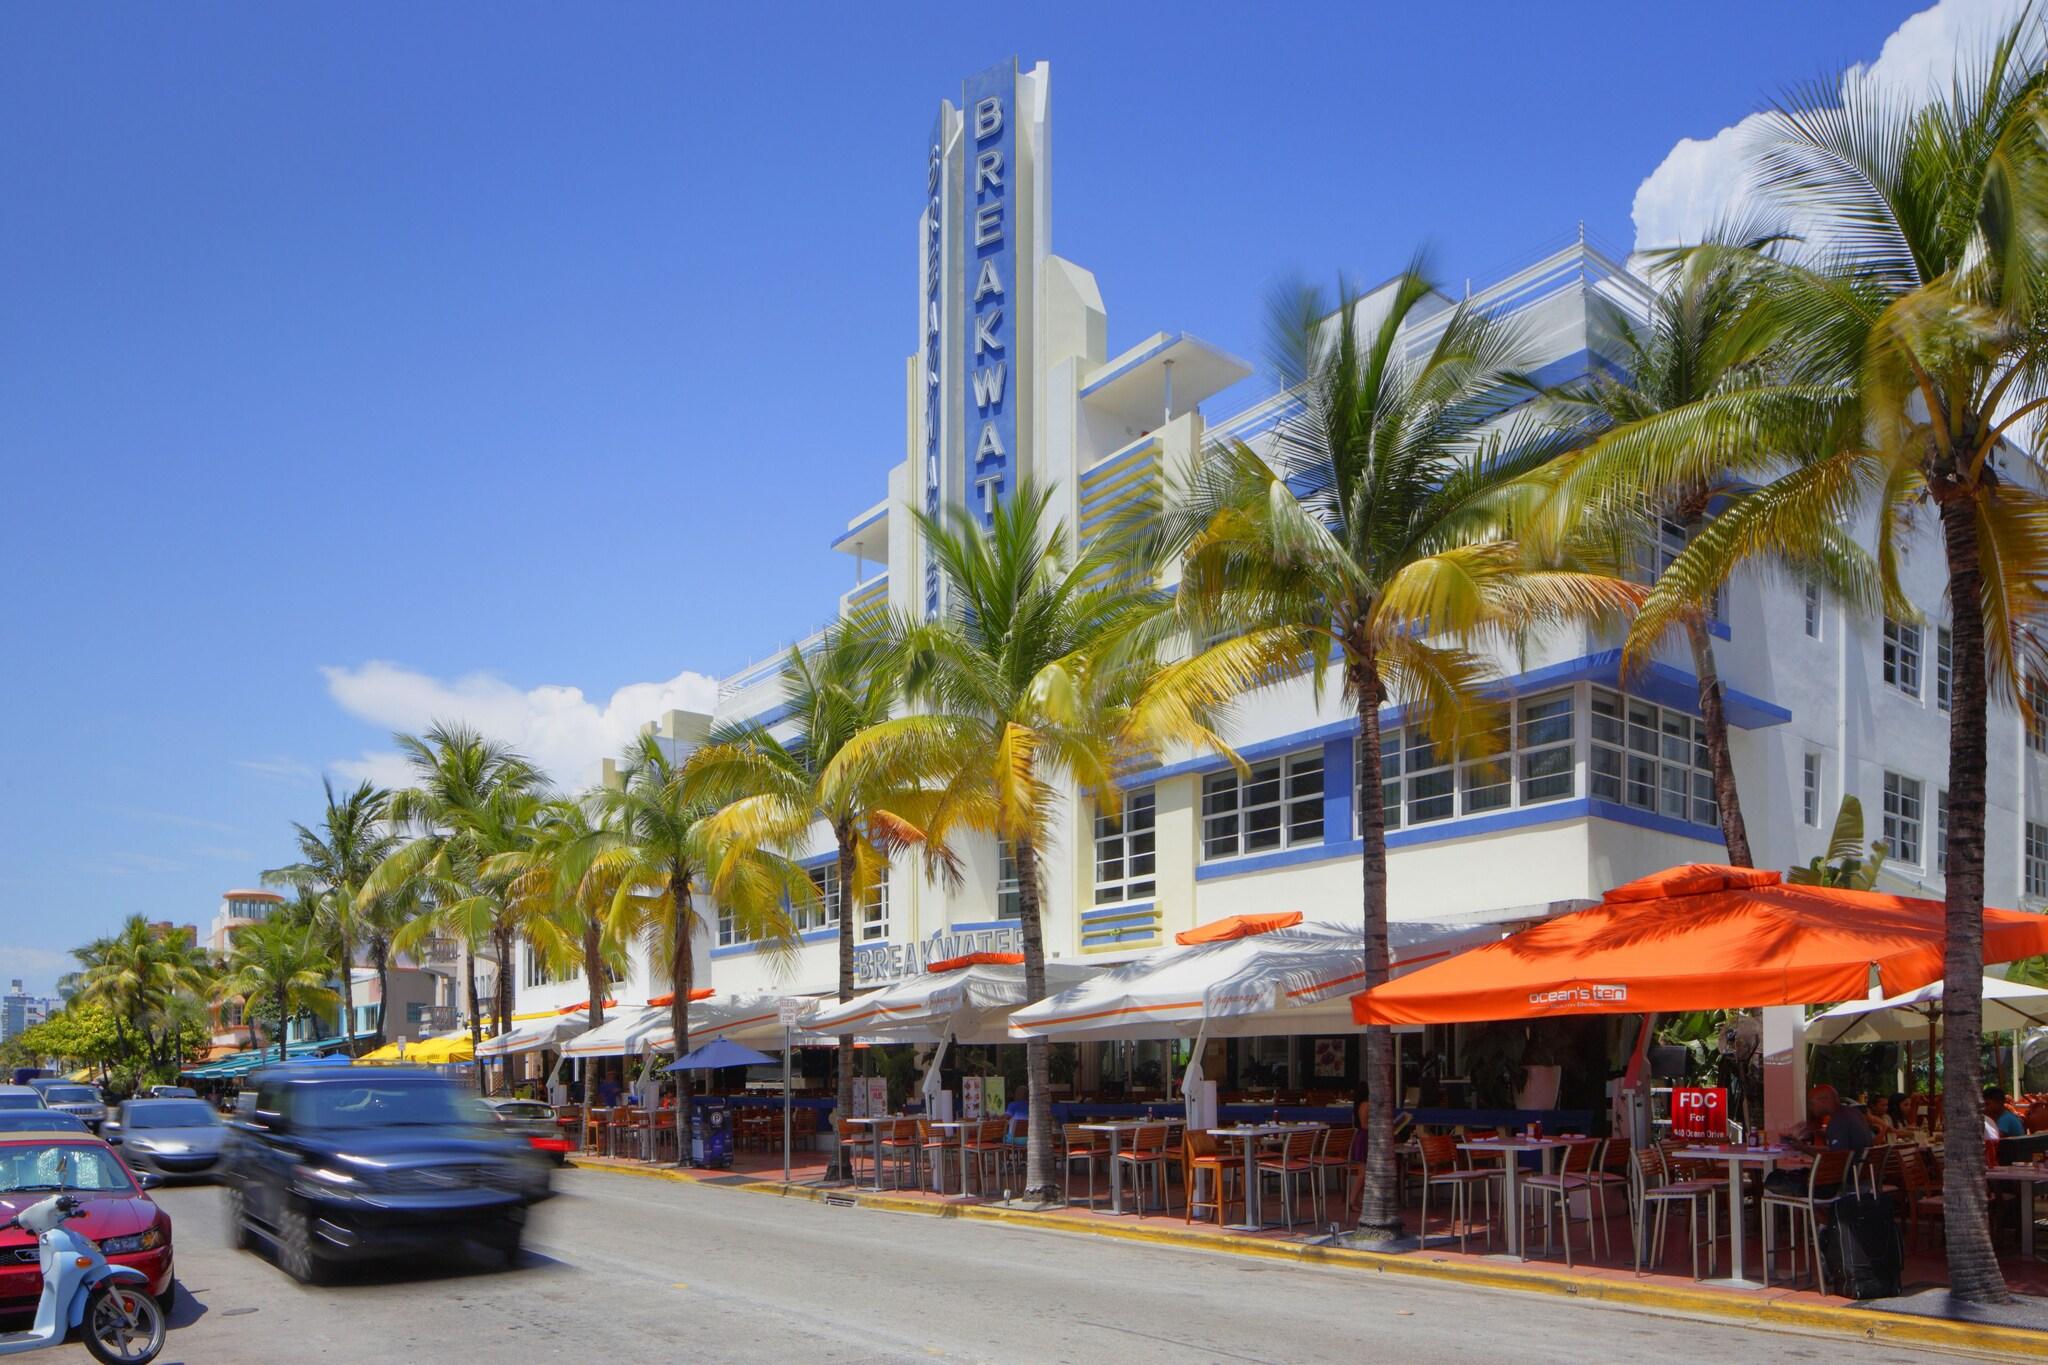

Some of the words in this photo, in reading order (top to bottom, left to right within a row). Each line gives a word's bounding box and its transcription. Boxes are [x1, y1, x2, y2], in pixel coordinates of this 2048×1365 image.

[972, 96, 1007, 550] BREAKWAT
[1529, 986, 1590, 1004] ocean's
[1594, 985, 1626, 1001] ten
[1680, 1092, 1717, 1108] FDC
[1690, 1113, 1705, 1122] For
